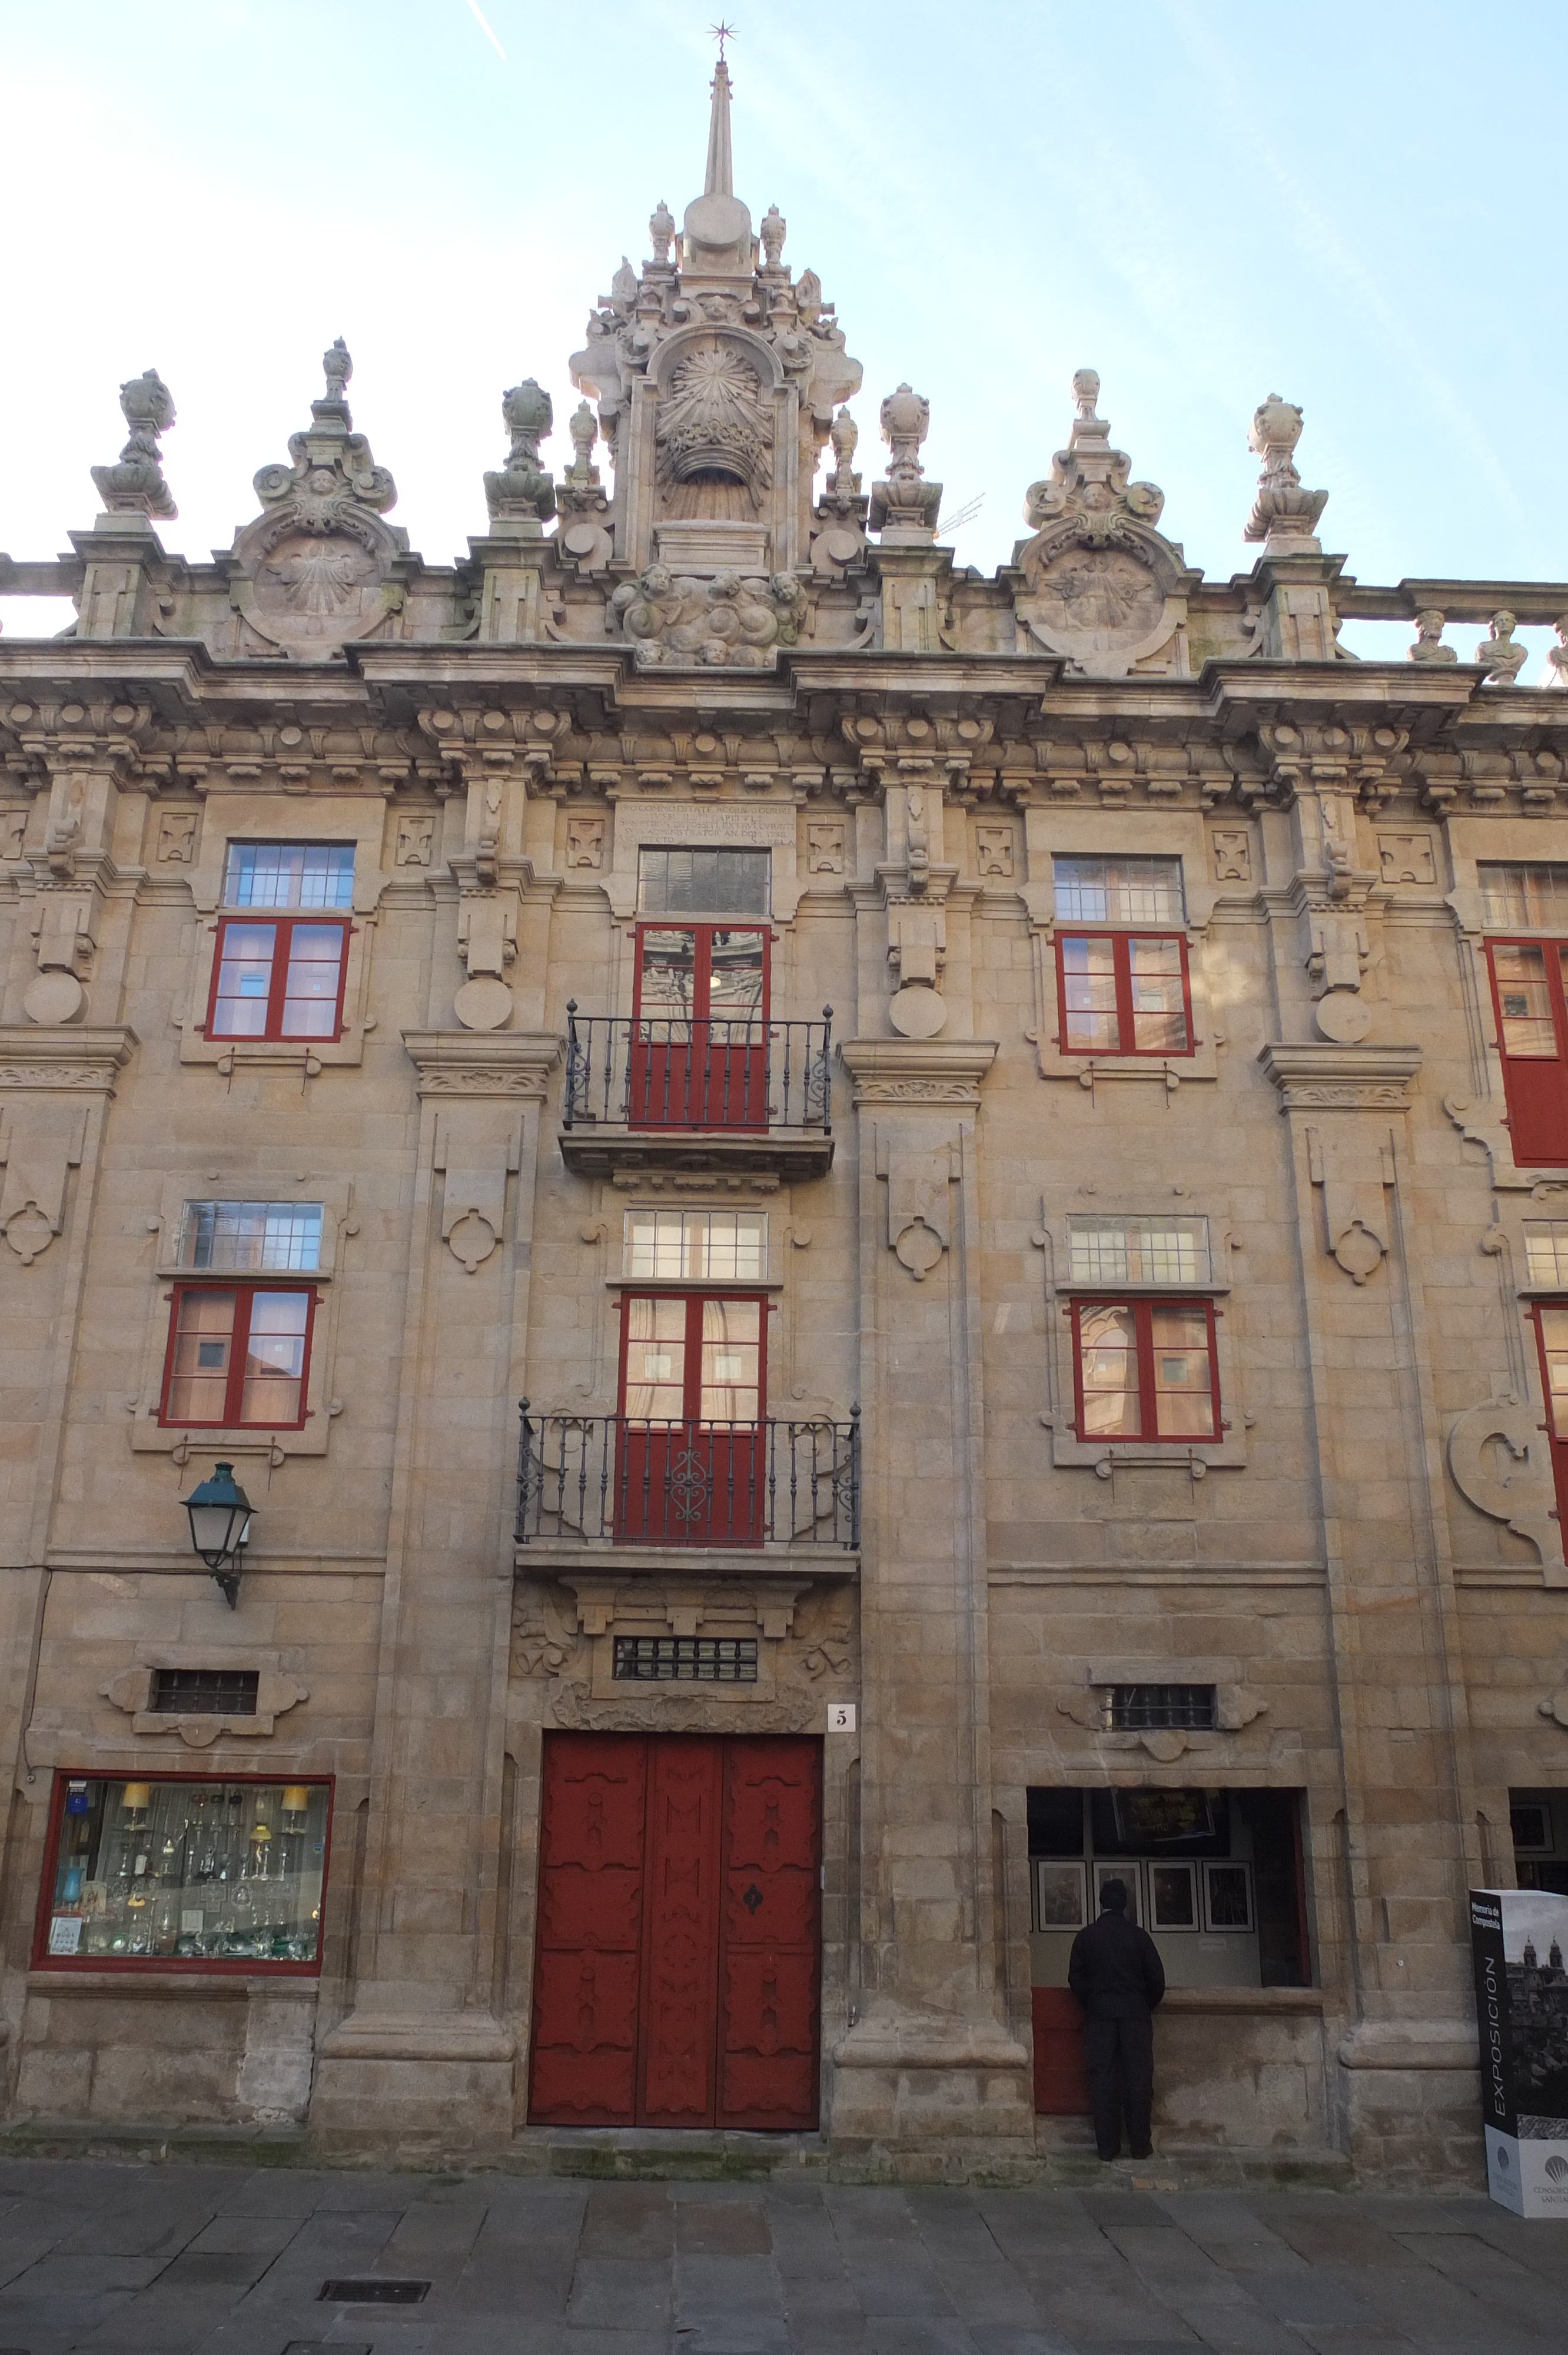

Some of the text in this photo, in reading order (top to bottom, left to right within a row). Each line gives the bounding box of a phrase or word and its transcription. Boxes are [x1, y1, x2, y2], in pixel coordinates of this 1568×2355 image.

[836, 1710, 847, 1726] 5
[1471, 1901, 1499, 1916] Memoria de
[1484, 1956, 1506, 2117] EXPOSICIÓN
